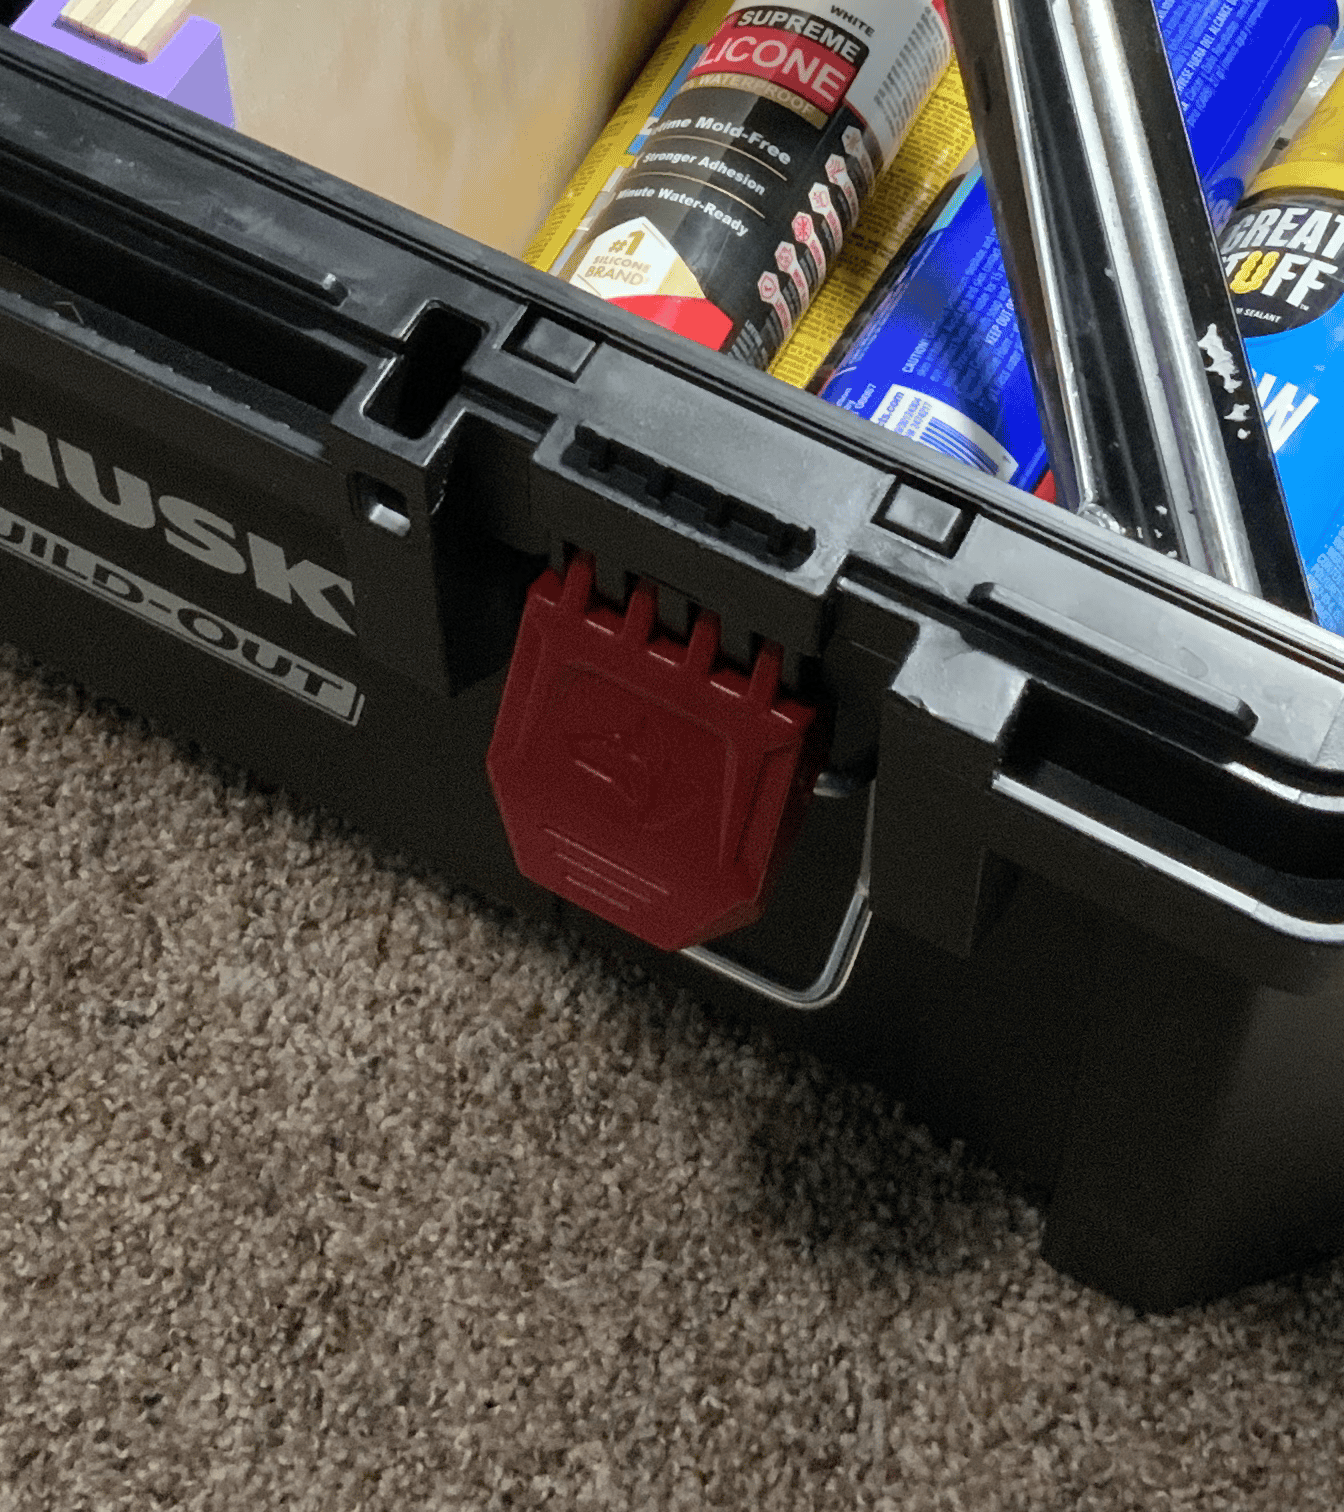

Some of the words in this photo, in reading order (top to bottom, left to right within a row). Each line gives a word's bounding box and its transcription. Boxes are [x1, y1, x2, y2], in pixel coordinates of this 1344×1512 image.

[737, 9, 861, 64] SUPREME
[830, 4, 876, 38] WHITE
[691, 35, 848, 104] LICONE
[699, 72, 818, 116] WATERPROOF
[694, 116, 792, 165] Mold-Free
[697, 156, 766, 196] Adhesion
[657, 187, 750, 237] Water-Ready
[592, 254, 652, 274] SILICONE
[608, 229, 646, 257] #1
[584, 264, 644, 287] BRAND
[1221, 249, 1339, 308] TUFF
[1243, 307, 1283, 324] SEALANT
